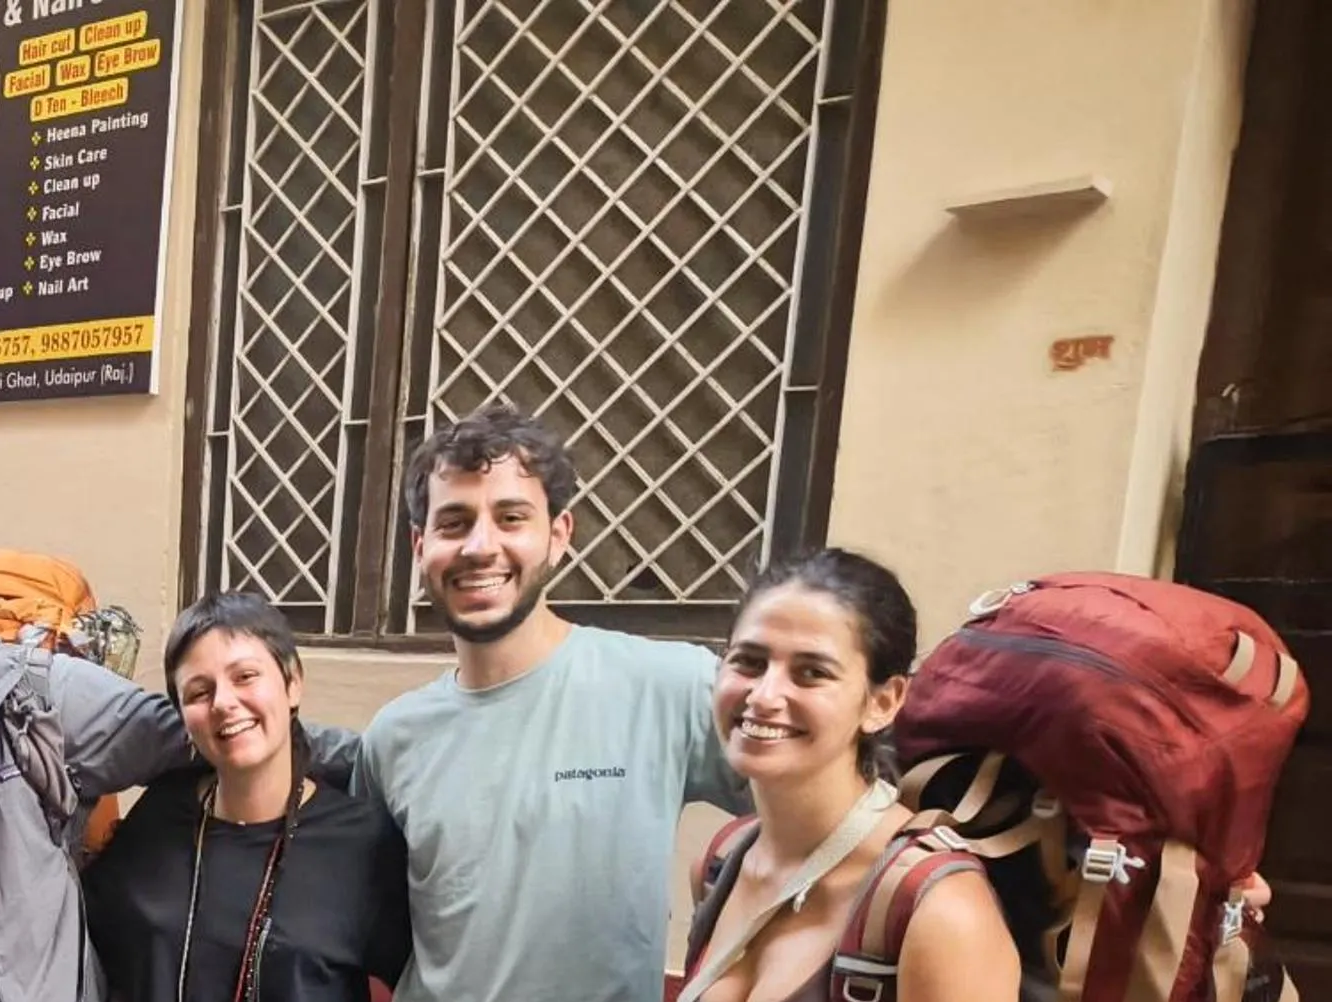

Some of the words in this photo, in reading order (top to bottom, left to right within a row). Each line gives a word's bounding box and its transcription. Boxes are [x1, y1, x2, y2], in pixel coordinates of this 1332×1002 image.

[4, 0, 22, 26] &
[84, 25, 121, 44] Clean
[125, 18, 141, 36] up
[22, 40, 47, 60] Hair
[97, 53, 119, 73] Eye
[123, 44, 157, 64] Brow
[9, 68, 45, 93] Facial
[61, 65, 86, 82] Wax
[34, 101, 43, 117] D
[46, 97, 67, 114] Ten
[46, 125, 86, 143] Heena
[91, 112, 149, 134] Painting
[44, 153, 74, 171] Skin
[77, 148, 108, 164] Care
[43, 176, 79, 194] Clean
[83, 173, 100, 190] up
[41, 201, 80, 222] Facial
[41, 230, 67, 246] Wax
[39, 254, 63, 272] Eye
[66, 250, 102, 267] Brow
[38, 279, 64, 296] Nail
[67, 276, 89, 293] Art
[41, 324, 144, 352] 9887057957
[45, 366, 97, 388] Udaipur
[554, 766, 626, 782] patagonia
